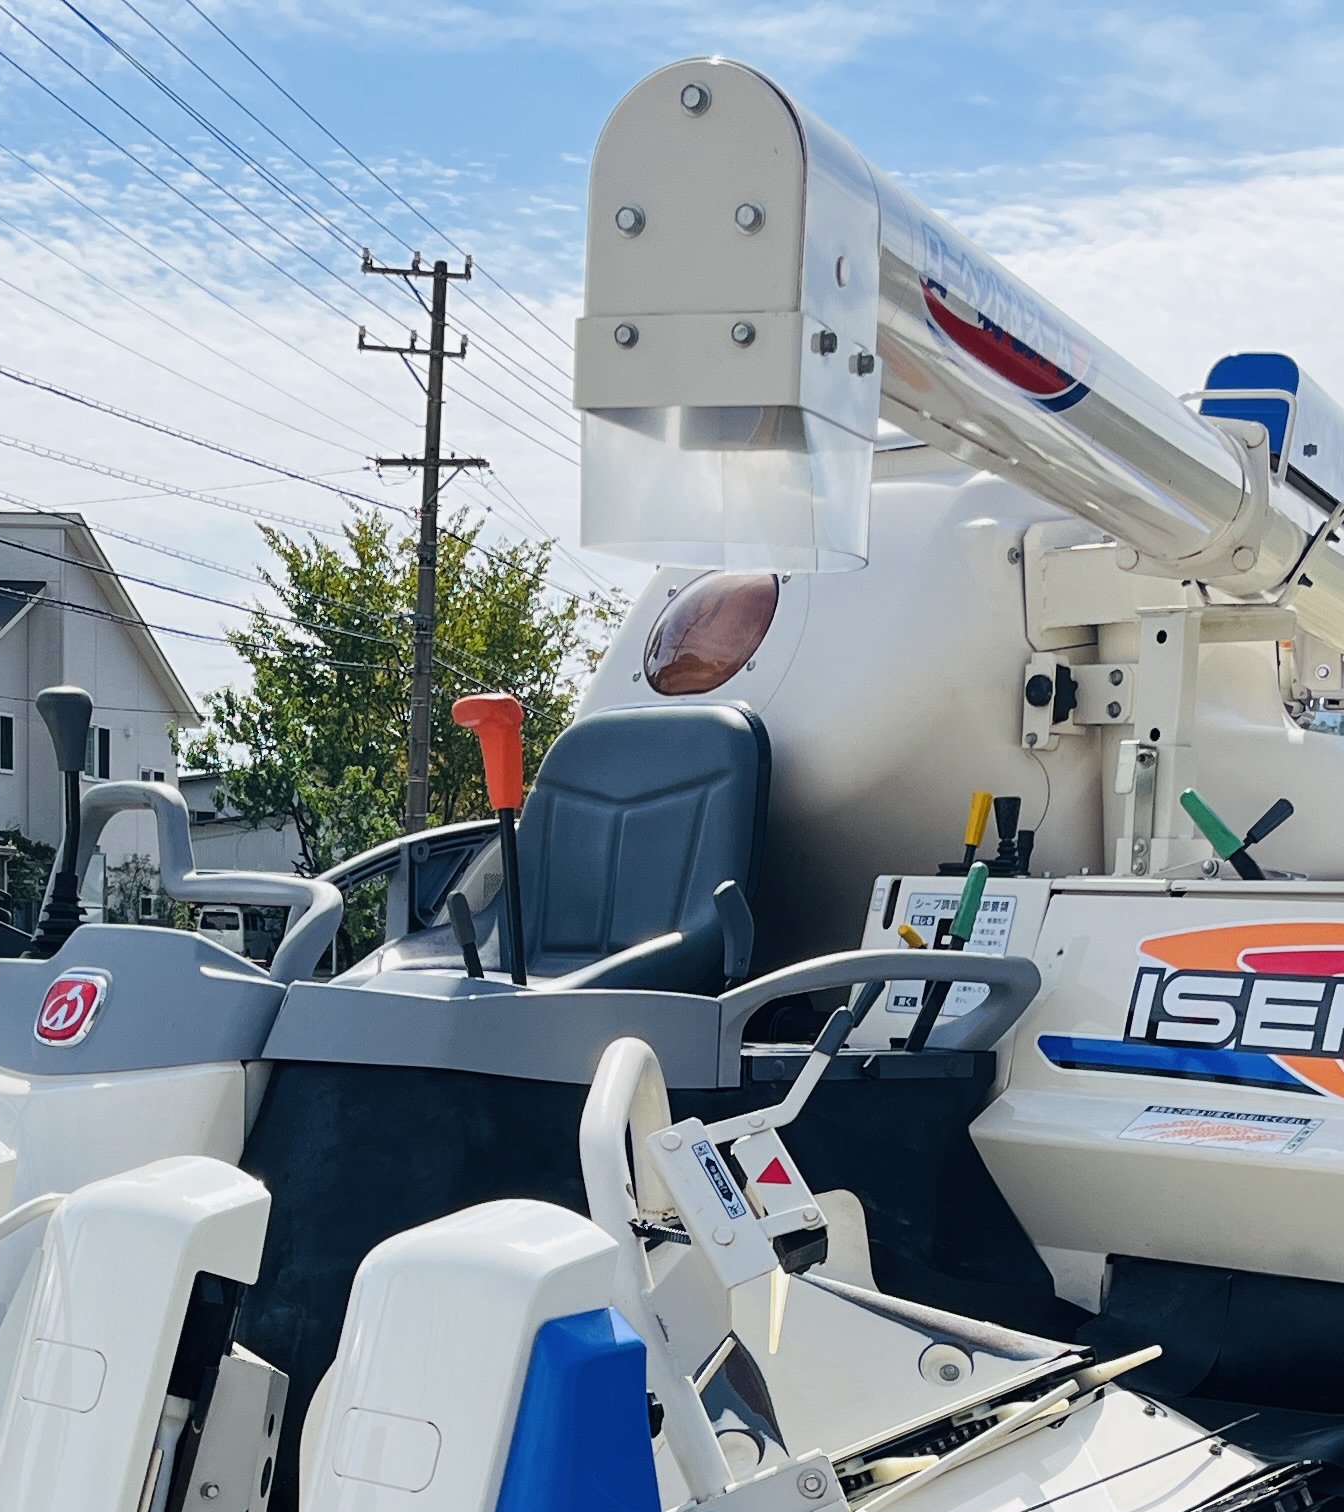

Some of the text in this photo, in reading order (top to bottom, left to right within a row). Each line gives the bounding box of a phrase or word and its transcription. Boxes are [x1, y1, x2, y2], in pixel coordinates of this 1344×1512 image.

[914, 899, 1009, 912] シーブ調節節要領
